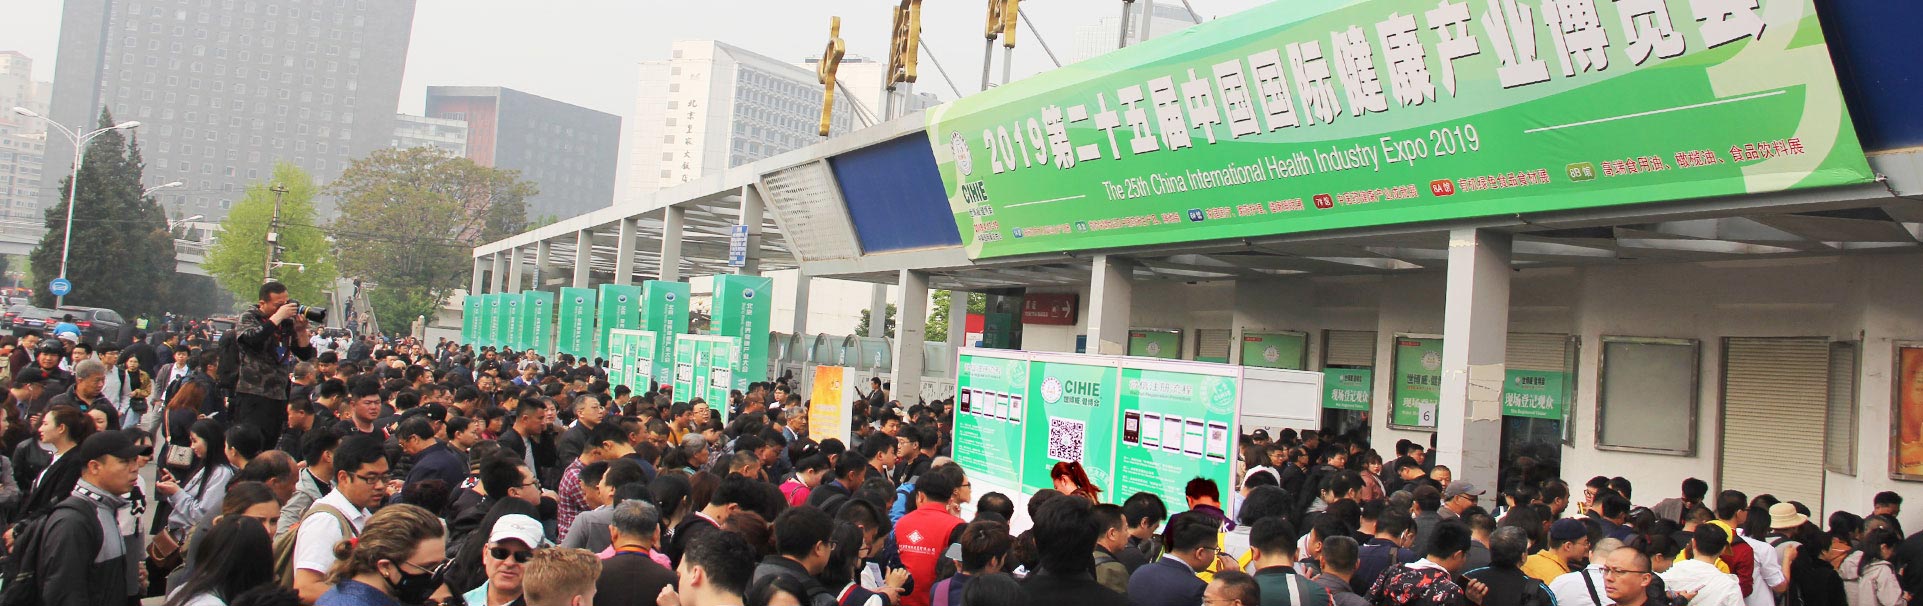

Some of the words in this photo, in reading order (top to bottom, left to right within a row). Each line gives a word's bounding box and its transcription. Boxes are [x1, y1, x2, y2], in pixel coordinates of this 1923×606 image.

[1102, 180, 1125, 201] The
[1124, 176, 1151, 199] 25th
[1150, 172, 1188, 196] China
[1186, 158, 1267, 191] International
[1264, 150, 1315, 180] Health
[1314, 142, 1379, 173] Industry
[1380, 136, 1428, 167] Expo
[1429, 123, 1480, 157] 2019
[1569, 167, 1582, 178] 8B
[962, 181, 988, 204] CIHIE
[1064, 380, 1100, 397] CIHIE
[1331, 388, 1370, 403] 现场登记观众
[1505, 392, 1554, 410] 现场登记观众
[1423, 411, 1430, 421] 6
